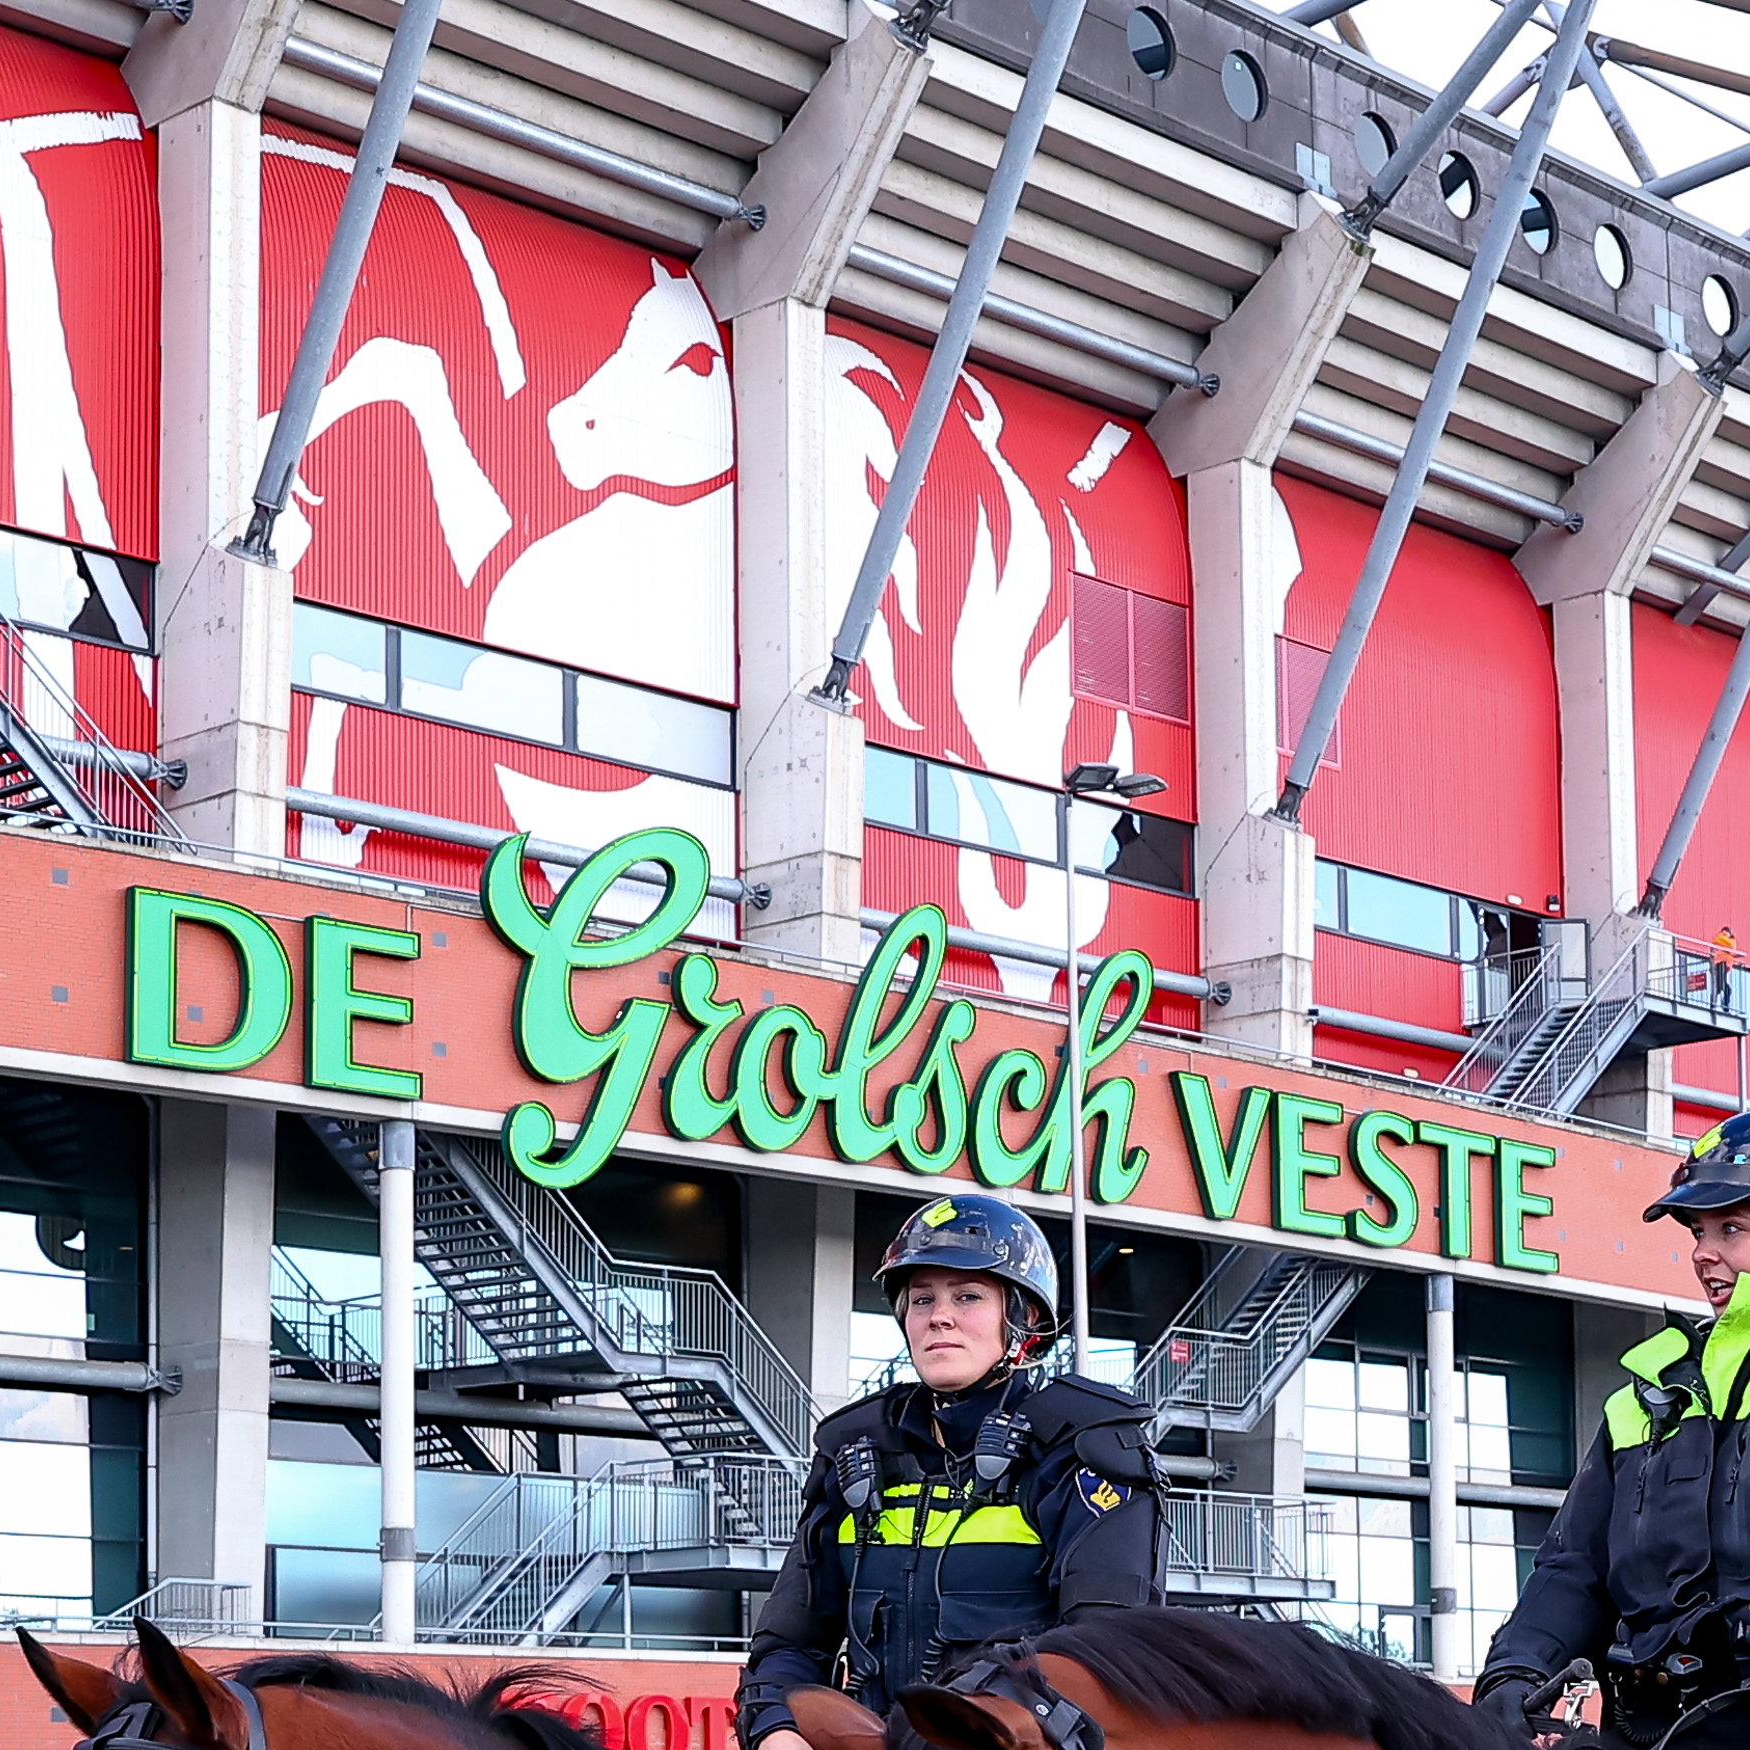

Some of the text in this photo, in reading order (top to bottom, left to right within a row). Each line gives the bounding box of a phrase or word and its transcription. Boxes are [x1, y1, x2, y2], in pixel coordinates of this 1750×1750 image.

[126, 826, 1560, 1274] DE Grolsch VESTE
